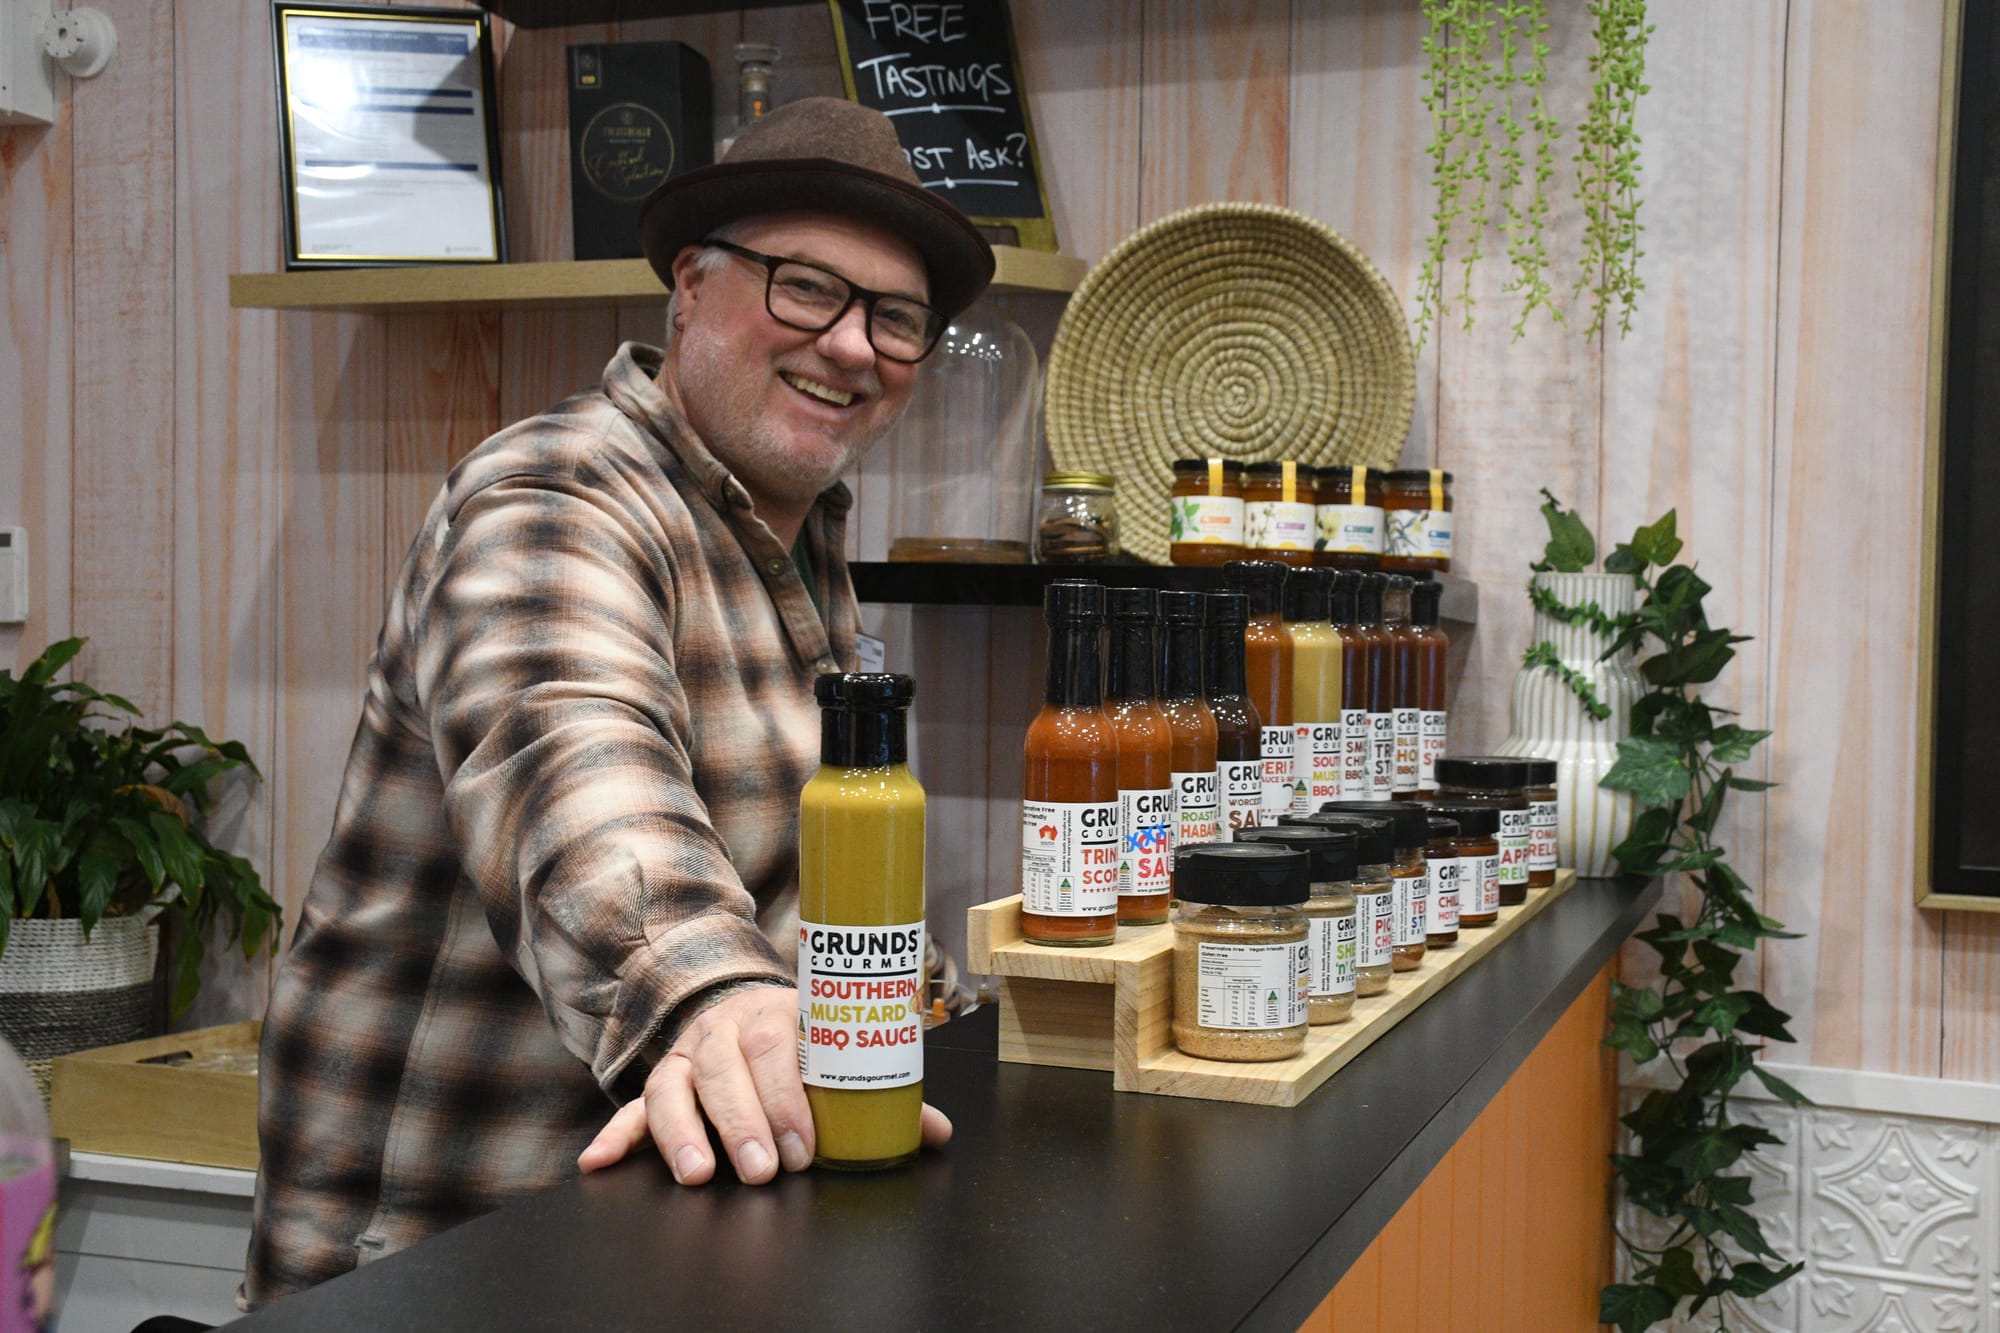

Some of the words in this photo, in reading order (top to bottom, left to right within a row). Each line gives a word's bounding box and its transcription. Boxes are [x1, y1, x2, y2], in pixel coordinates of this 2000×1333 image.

[863, 0, 967, 43] FREE
[857, 53, 1012, 102] TASTINGS
[1228, 766, 1261, 781] GRU
[1181, 777, 1217, 793] GRU
[1081, 808, 1118, 827] GRU
[811, 930, 917, 955] GRUNDS
[811, 955, 917, 969] GOURMET
[811, 978, 917, 1000] SOUTHERN
[810, 1002, 906, 1023] MUSTARD
[810, 1026, 849, 1050] BBQ
[856, 1025, 917, 1048] SAUCE
[820, 1071, 911, 1083] www.grundsgourmet.com
